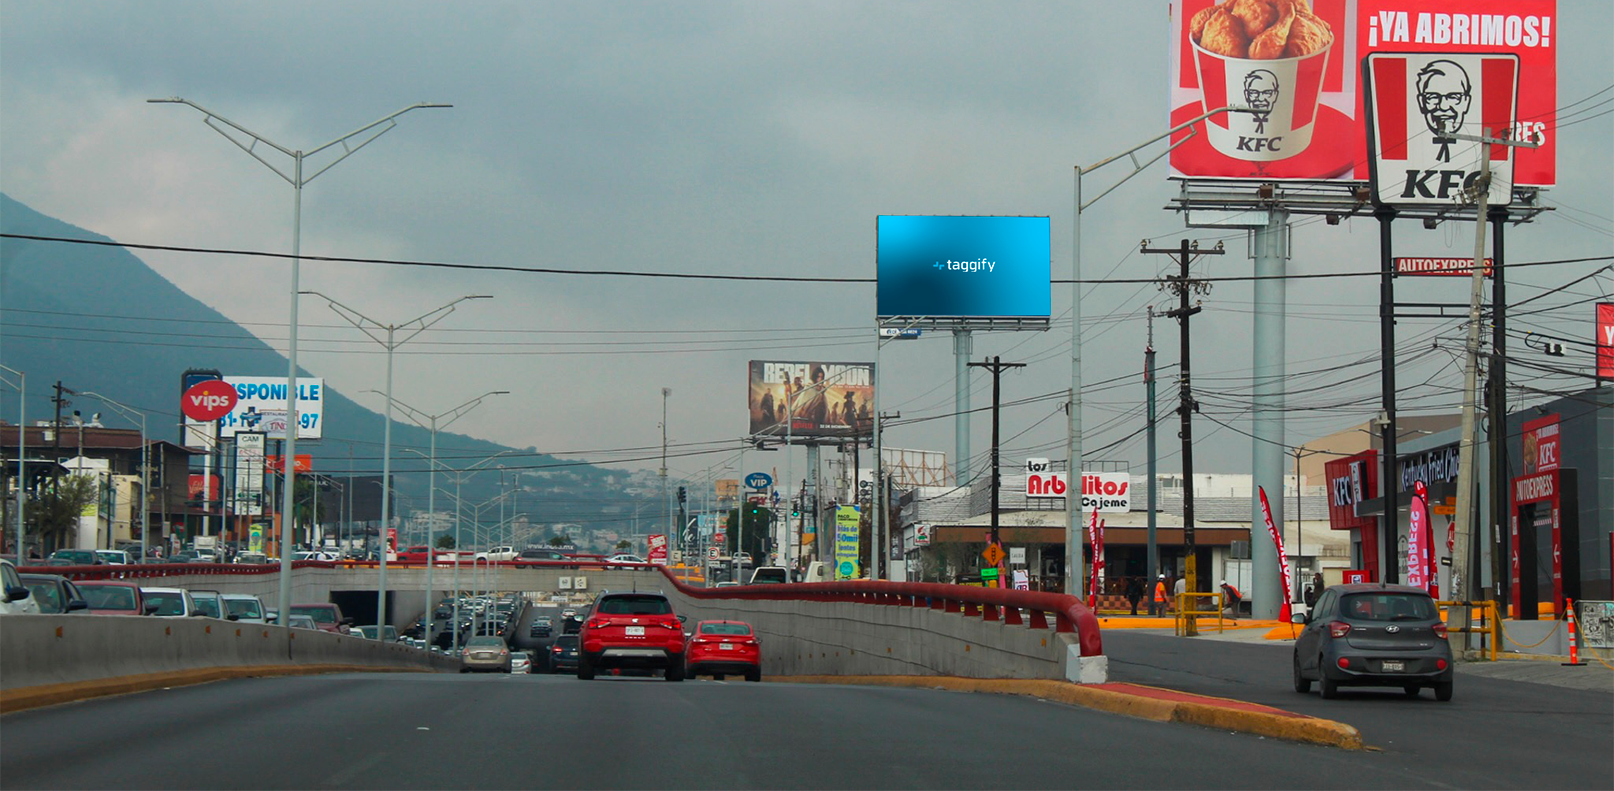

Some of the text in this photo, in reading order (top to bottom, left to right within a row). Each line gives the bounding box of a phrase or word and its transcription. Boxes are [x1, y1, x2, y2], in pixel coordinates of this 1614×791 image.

[1368, 11, 1551, 48] ¡YA ABRIMOS!
[1236, 135, 1283, 152] KFC
[946, 258, 996, 273] taggify
[1398, 258, 1492, 274] AUTOEXPRES
[190, 390, 229, 411] vips
[1539, 441, 1556, 466] KFC
[1027, 460, 1048, 472] Los
[1428, 450, 1444, 486] Fried
[750, 479, 768, 488] VIP
[1028, 474, 1128, 496] Arblitos
[1333, 475, 1351, 507] KFC
[1516, 474, 1554, 502] AUTOEXPRESS
[1081, 497, 1128, 511] Cajeme
